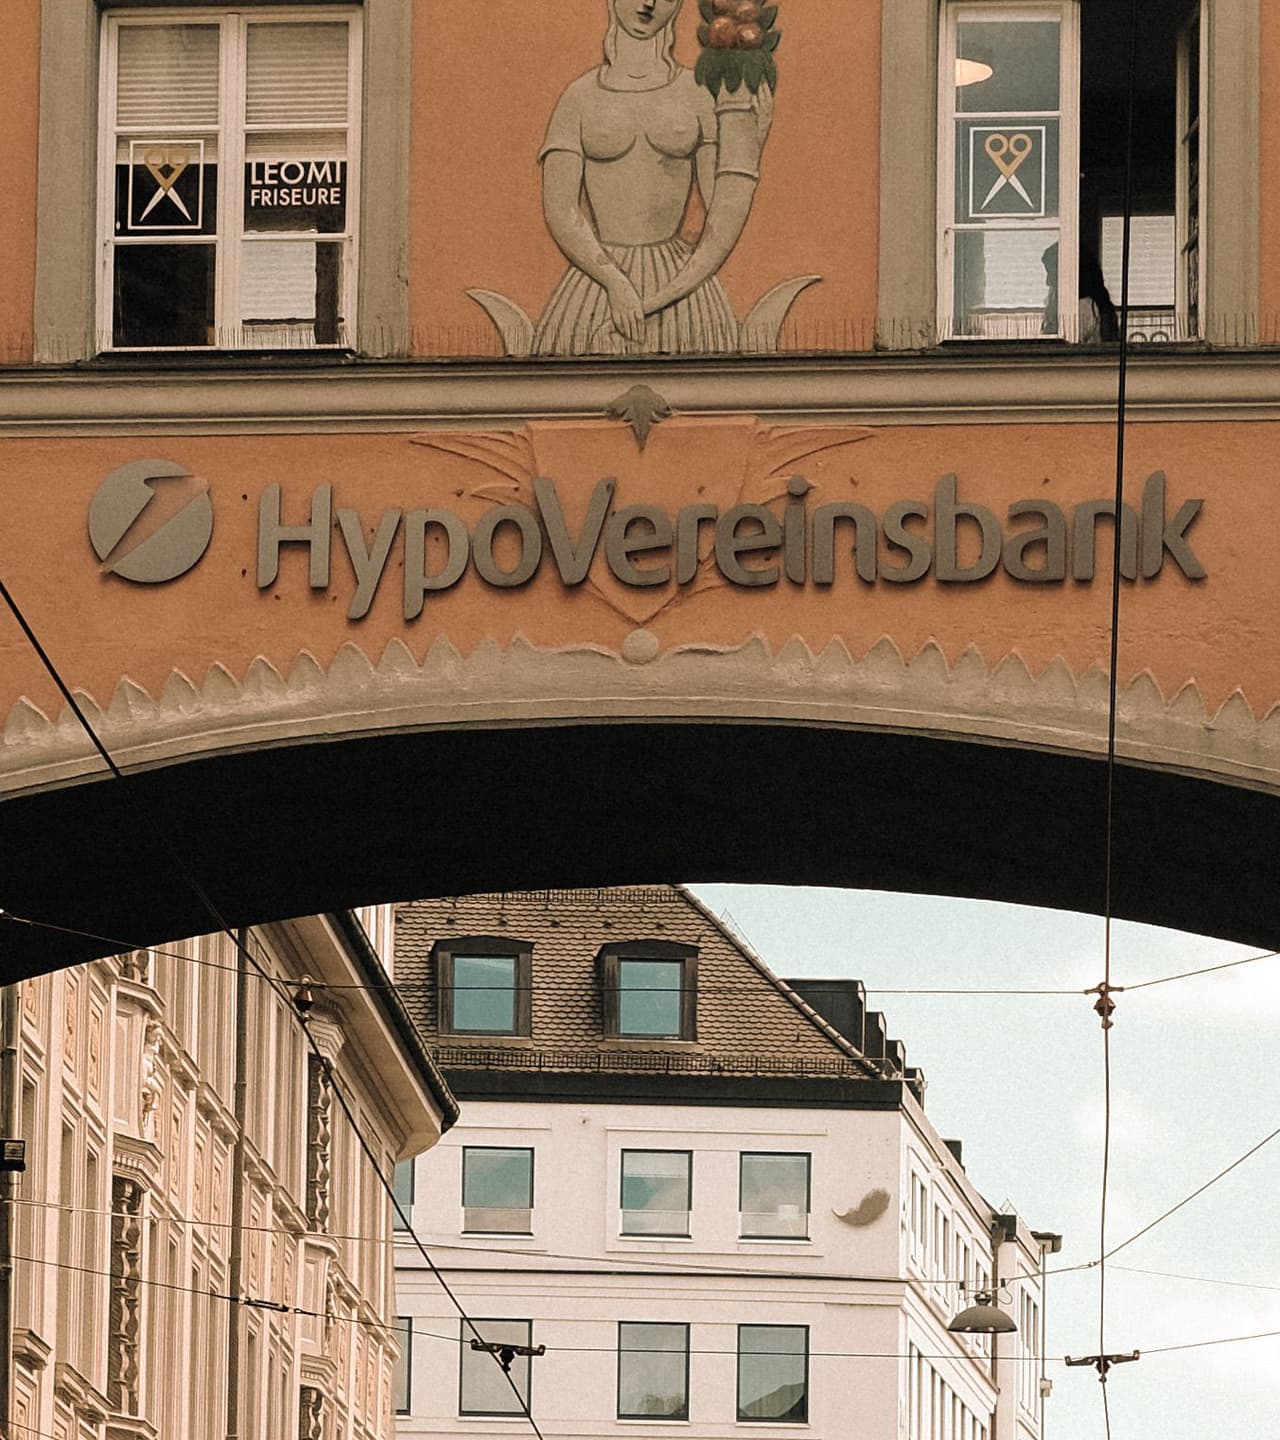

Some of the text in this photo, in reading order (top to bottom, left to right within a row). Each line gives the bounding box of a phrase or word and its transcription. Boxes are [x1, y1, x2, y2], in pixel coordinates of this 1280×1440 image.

[250, 160, 342, 185] LEOMI
[250, 186, 342, 207] FRISEURE
[254, 468, 1208, 620] HypoVereinsbank
